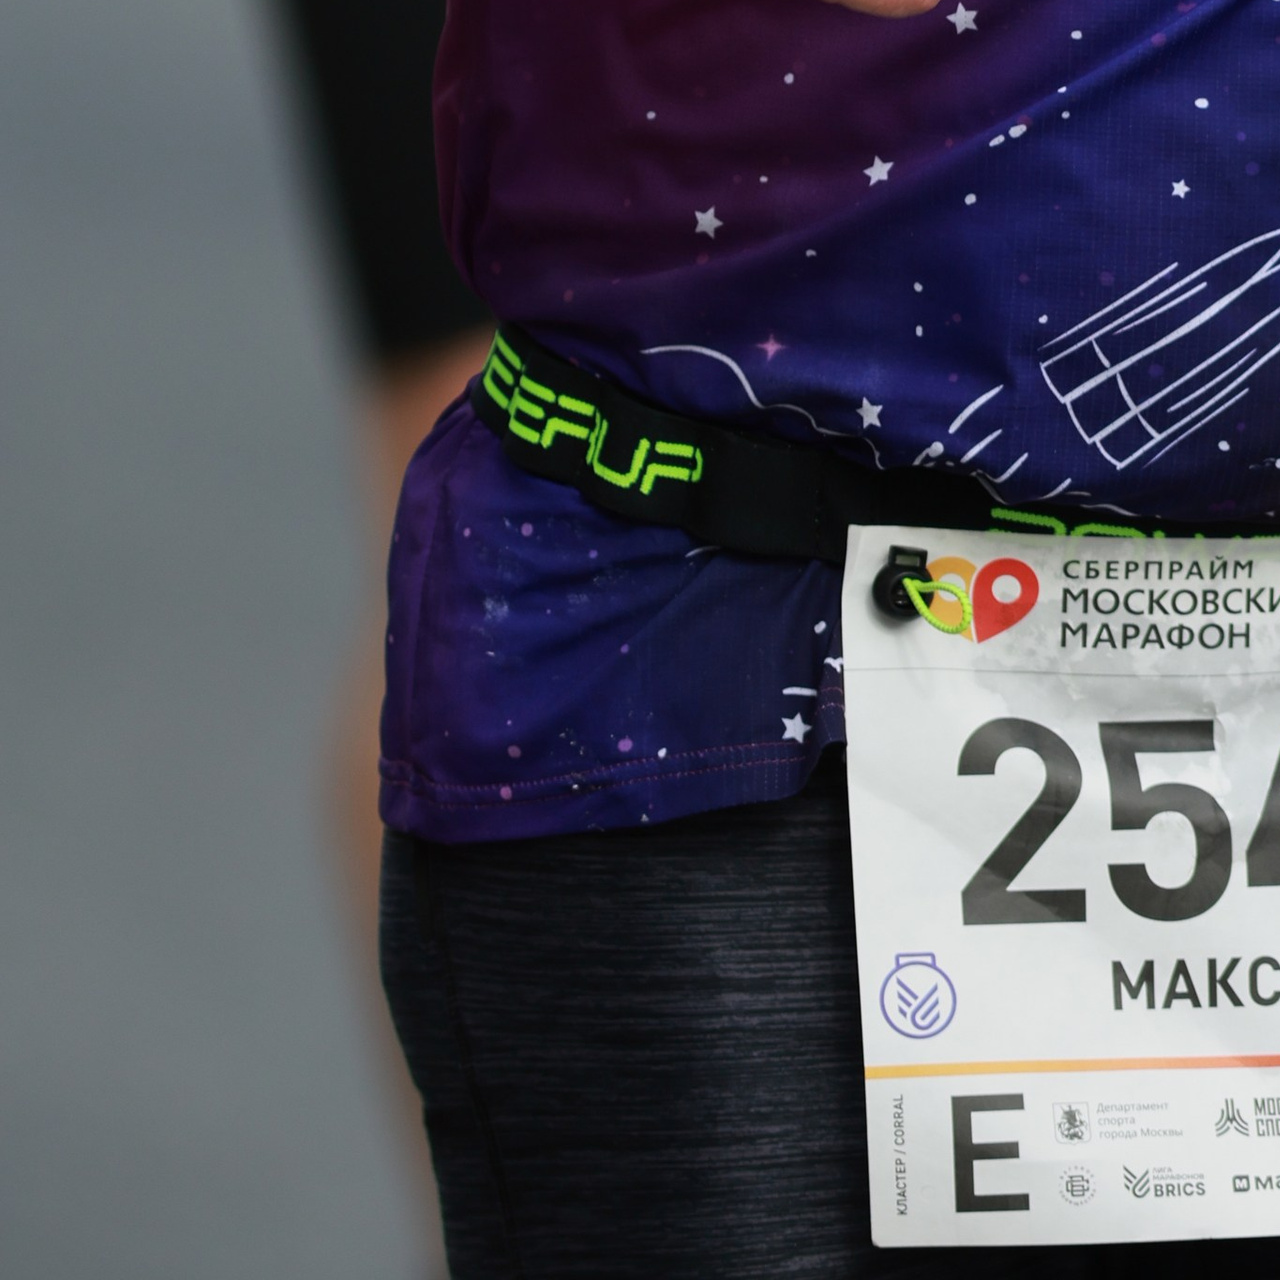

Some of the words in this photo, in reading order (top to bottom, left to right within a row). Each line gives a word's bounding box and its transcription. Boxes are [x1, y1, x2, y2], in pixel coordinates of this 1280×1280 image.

[1062, 556, 1254, 581] СБЕРПРАЙМ
[1059, 621, 1252, 650] МАРАФОН
[893, 1094, 905, 1146] CORRAL
[1096, 1101, 1169, 1114] Департамент
[1097, 1116, 1136, 1128] спорта
[1099, 1129, 1138, 1141] города
[1140, 1127, 1184, 1139] Москвы
[951, 1093, 1030, 1213] E
[895, 1157, 908, 1216] КЛАСТЕР
[1153, 1182, 1207, 1198] BRICS
